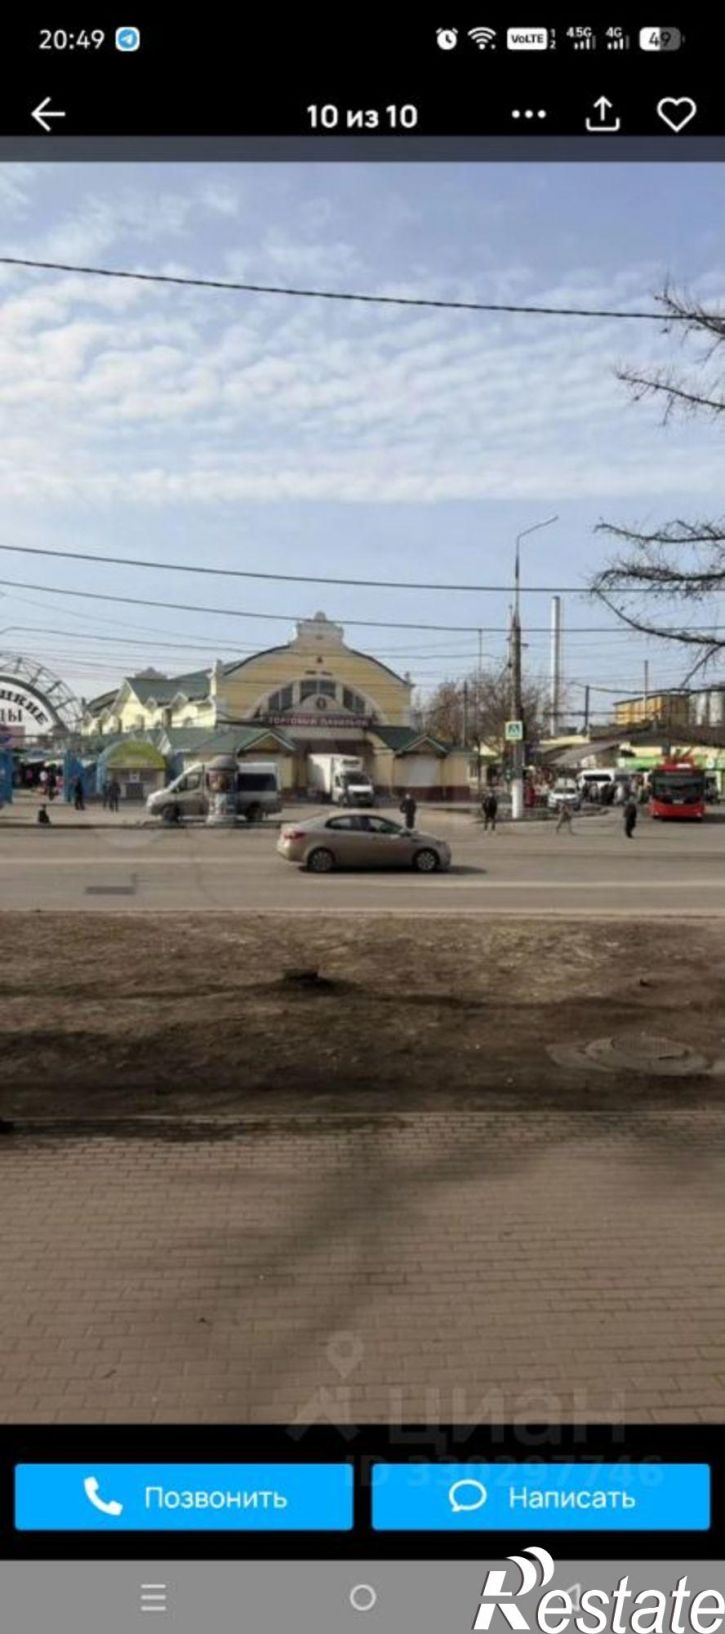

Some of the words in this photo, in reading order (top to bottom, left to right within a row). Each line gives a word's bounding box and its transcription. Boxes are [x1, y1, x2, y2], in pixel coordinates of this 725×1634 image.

[39, 29, 105, 49] 20:49
[511, 33, 544, 44] VoLTE
[605, 27, 623, 38] 4G
[648, 31, 672, 47] 49
[549, 40, 556, 50] 2
[307, 104, 338, 128] 10
[346, 109, 379, 128] из
[386, 104, 418, 128] 10
[145, 1486, 288, 1509] Позвонить
[509, 1486, 636, 1509] Написать
